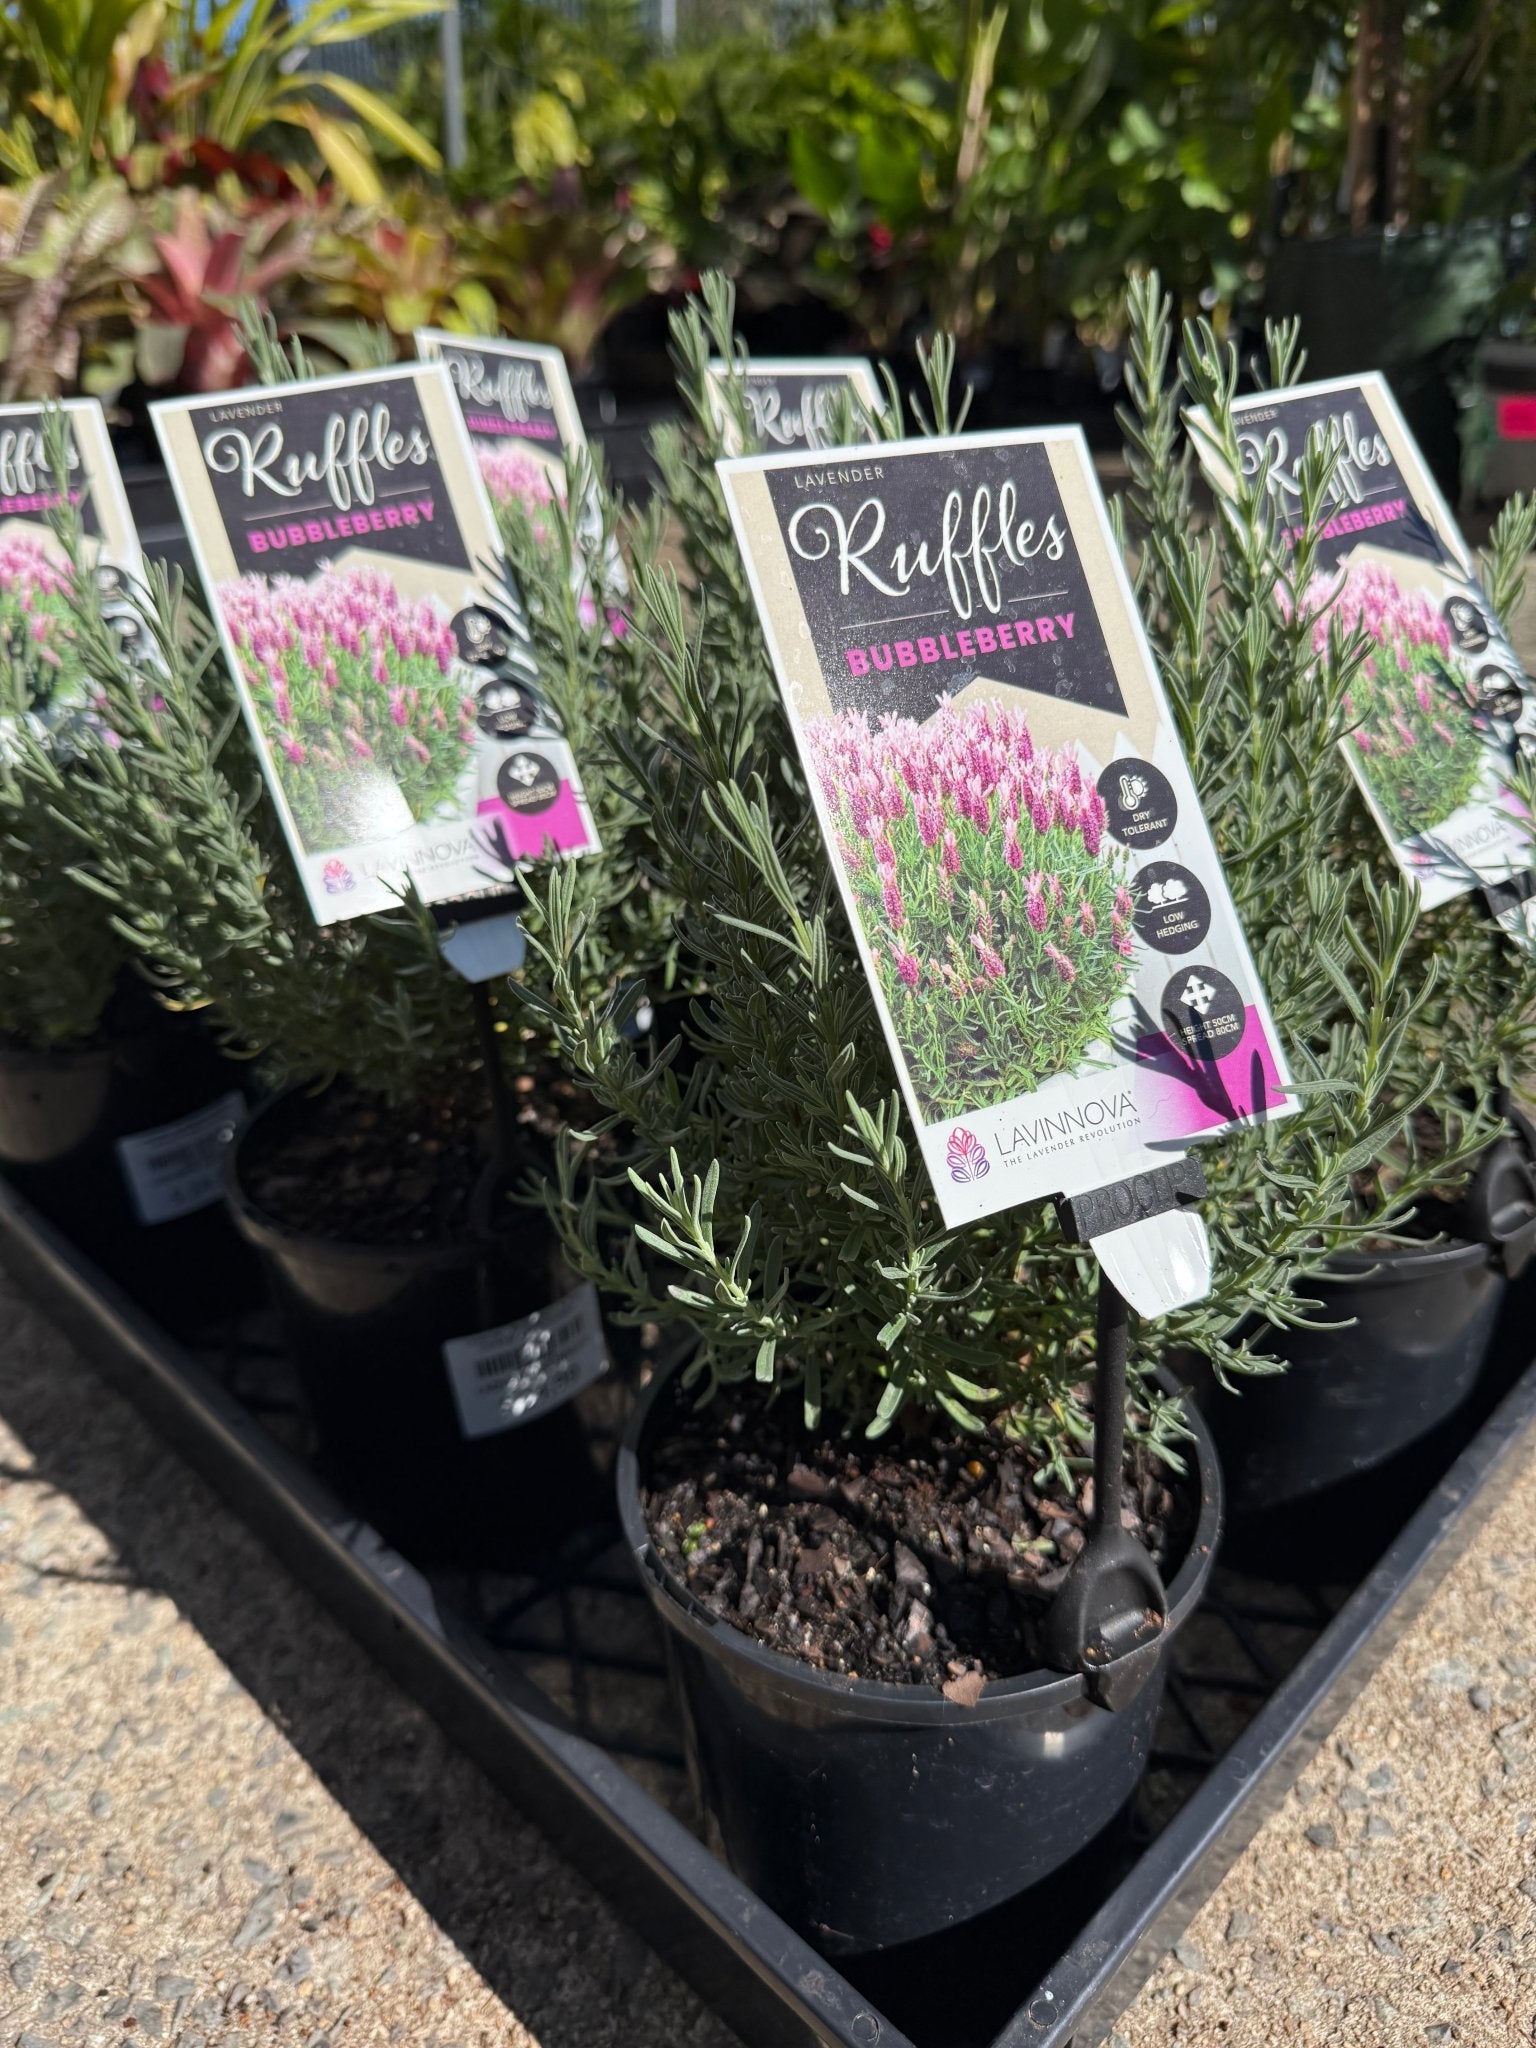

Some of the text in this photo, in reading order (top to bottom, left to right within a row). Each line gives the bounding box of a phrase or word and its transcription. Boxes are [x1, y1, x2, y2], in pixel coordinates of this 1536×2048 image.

[209, 401, 284, 423] LAVENDER
[203, 402, 430, 511] Ruffles
[794, 466, 885, 489] LAVENDER
[247, 499, 436, 554] BUBBLEBERRY
[788, 480, 1066, 620] Ruffles
[845, 613, 1076, 678] BUBBLEBERRY
[1122, 818, 1168, 837] TOLERANT
[1132, 810, 1151, 822] DRY
[1163, 911, 1184, 924] LOW
[1156, 920, 1199, 939] HEDGING
[1181, 1013, 1236, 1036] HEIGHT 50CM
[1182, 1022, 1240, 1046] SPREAD 80CM
[994, 1092, 1138, 1156] LAVINNOVA
[1004, 1117, 1142, 1168] THE LAVENDER REVOLUTION
